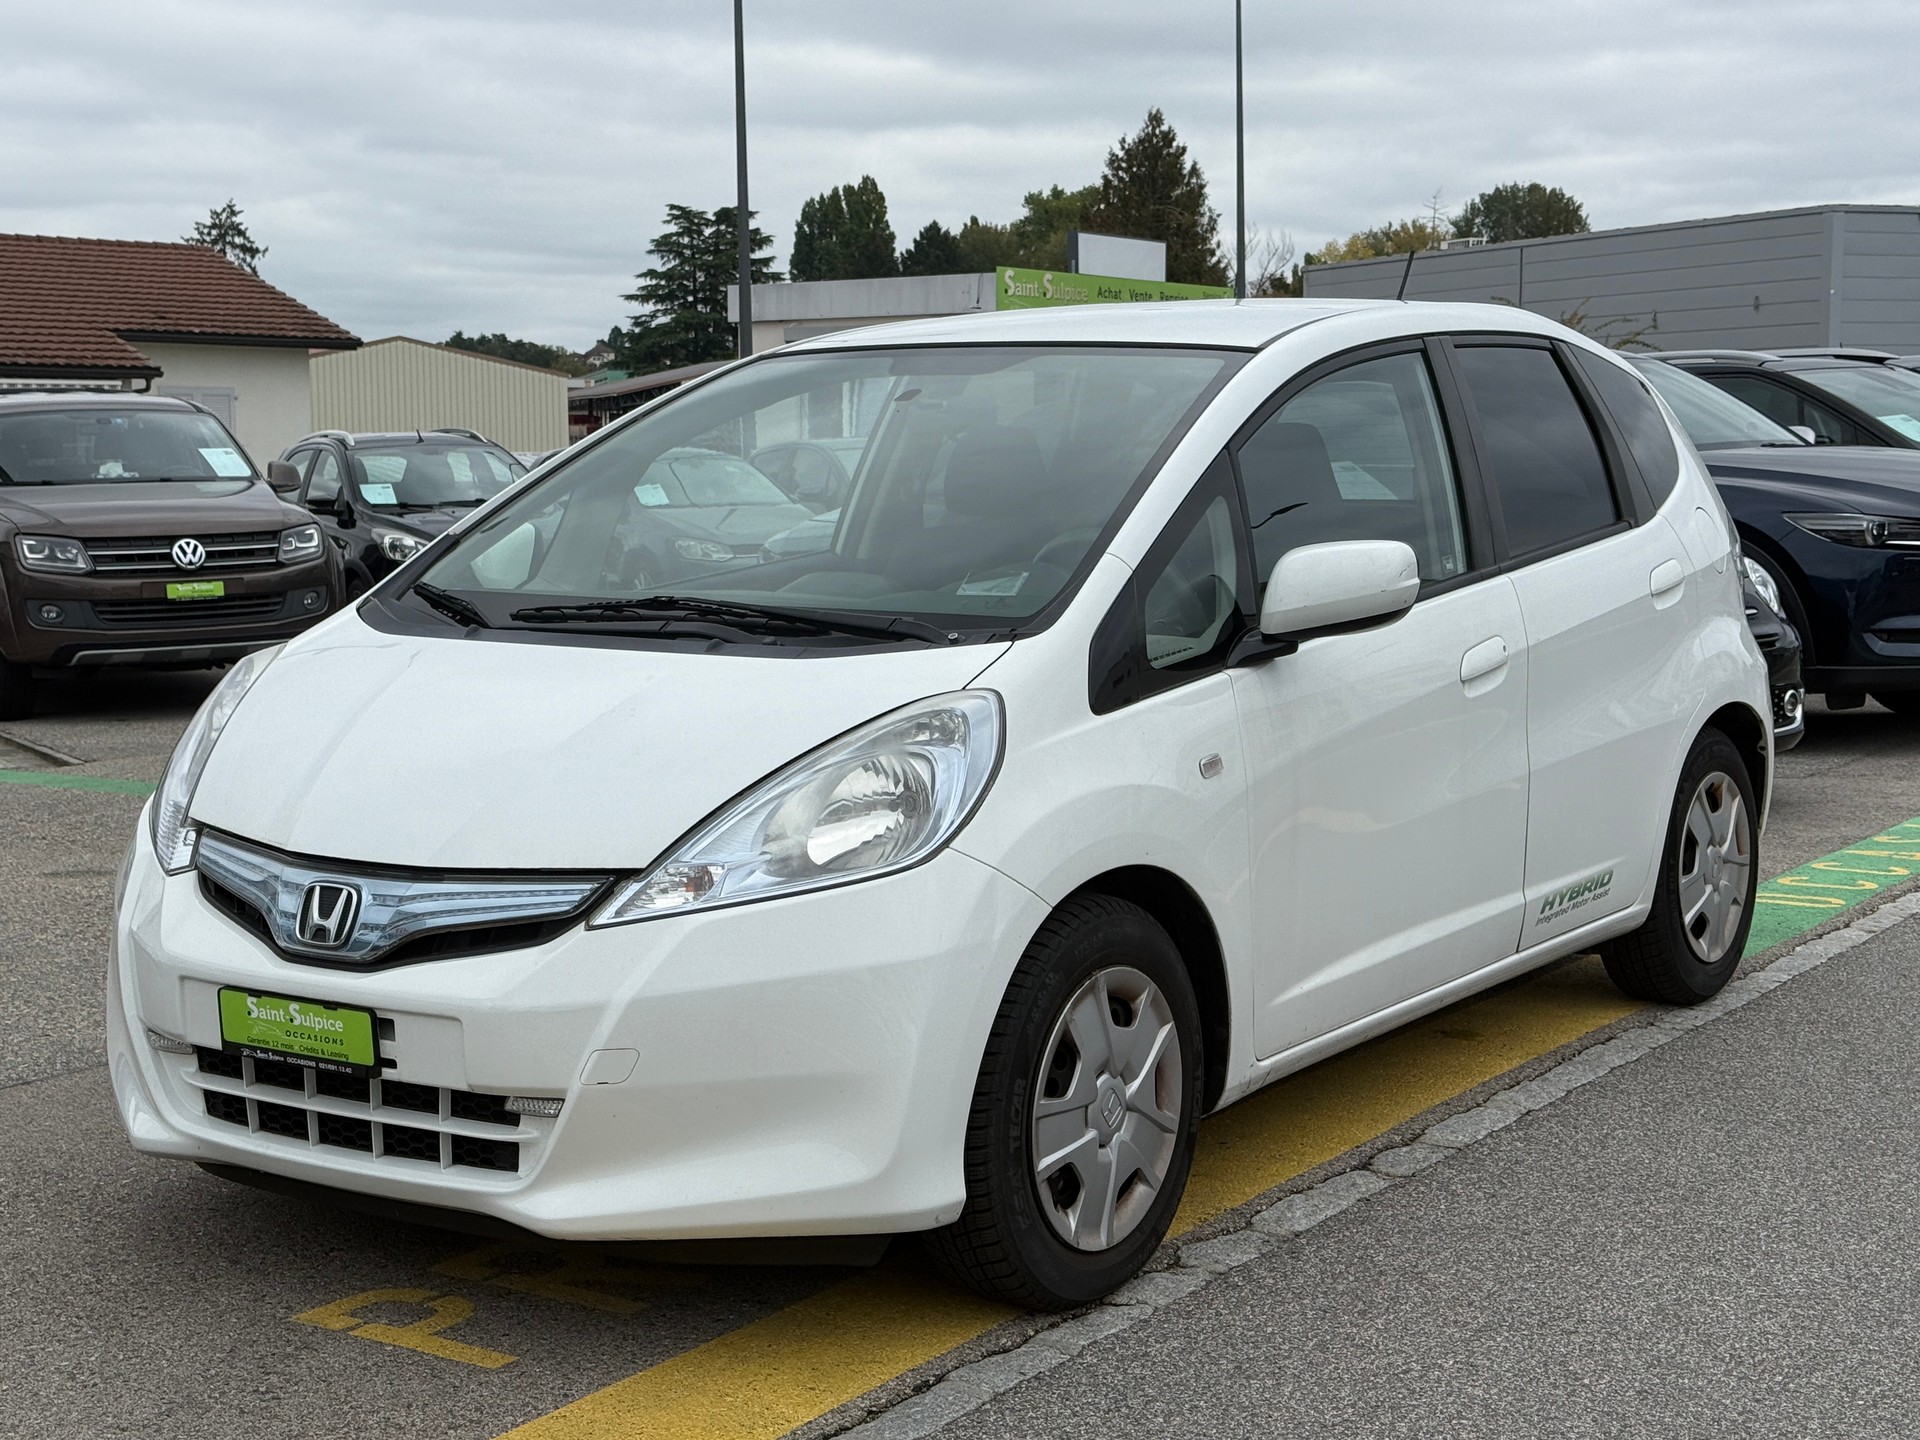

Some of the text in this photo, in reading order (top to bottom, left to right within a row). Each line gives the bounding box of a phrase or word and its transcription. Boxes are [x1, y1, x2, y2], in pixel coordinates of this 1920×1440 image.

[1004, 269, 1088, 303] Saint-Sulpice
[1097, 286, 1122, 300] Achat
[1129, 289, 1153, 301] Vente
[1535, 887, 1611, 927] Integrated Motor Assist
[1540, 868, 1614, 915] HYBRID
[247, 997, 344, 1031] Saint-Sulpice
[247, 1036, 349, 1061] Garantie 12 mois Crédits & Leasing
[285, 1029, 344, 1046] OCCASIONS
[286, 1056, 316, 1067] OCCASIONS
[1008, 1078, 1027, 1153] TECAR
